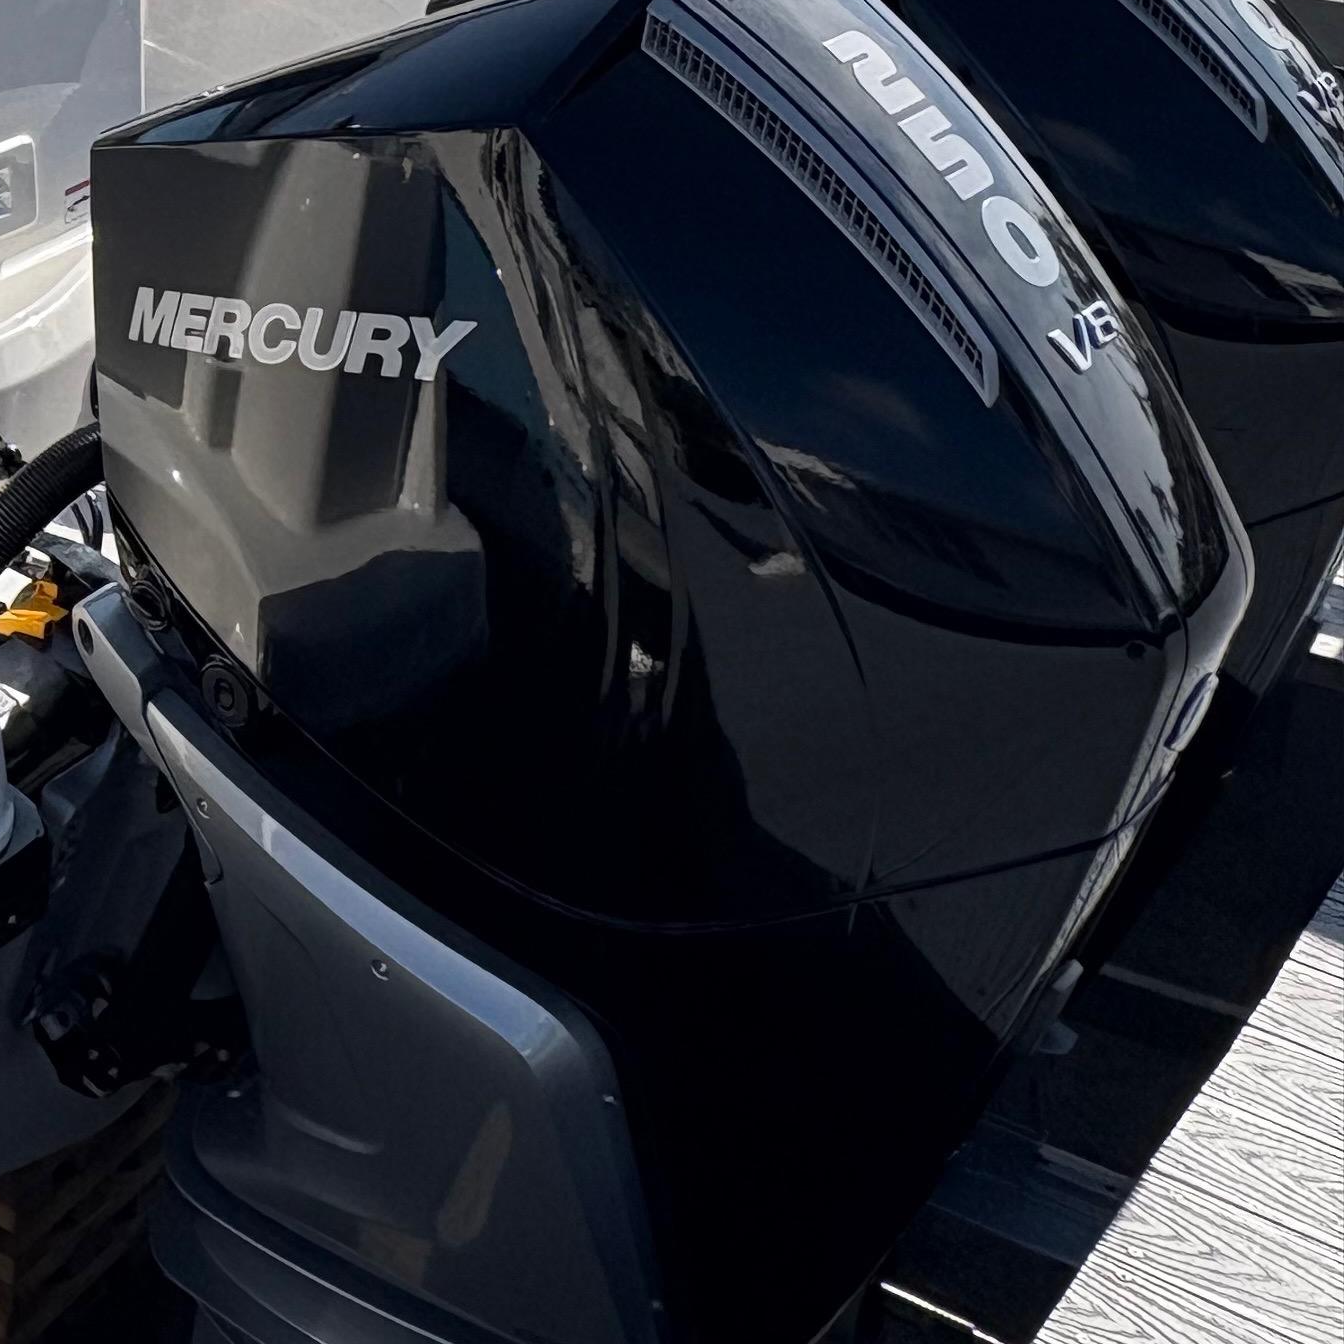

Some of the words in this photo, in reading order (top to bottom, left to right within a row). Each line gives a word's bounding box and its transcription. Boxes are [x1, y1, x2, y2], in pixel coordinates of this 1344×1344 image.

[822, 30, 1060, 288] 250
[128, 286, 478, 382] MERCURY
[1046, 299, 1121, 375] V8
